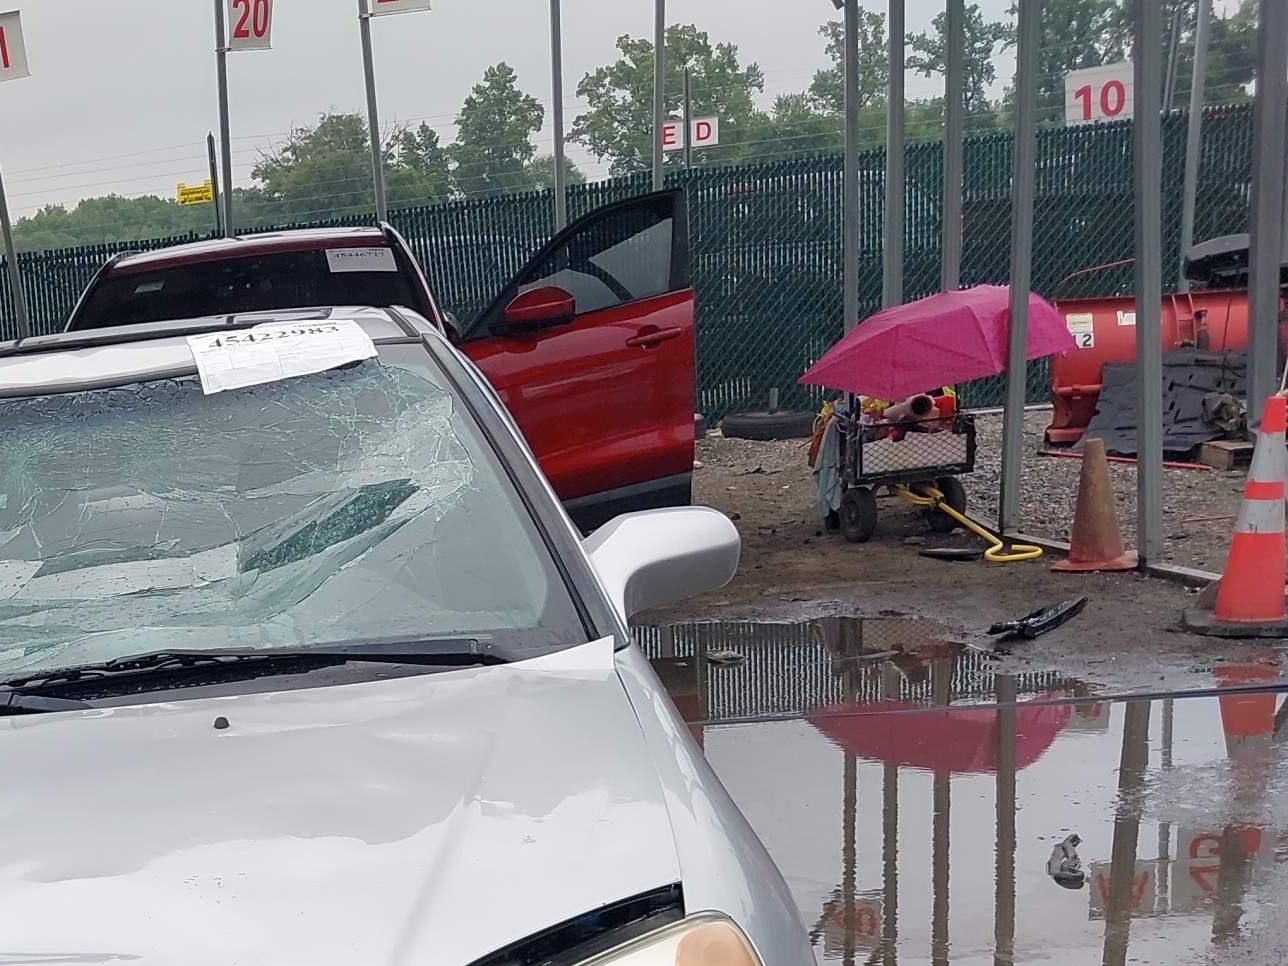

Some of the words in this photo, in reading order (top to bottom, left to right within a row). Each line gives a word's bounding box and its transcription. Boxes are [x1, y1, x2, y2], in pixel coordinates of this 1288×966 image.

[232, 0, 269, 39] 20
[1075, 80, 1125, 120] 10
[695, 122, 712, 141] D
[208, 326, 340, 348] 45422983
